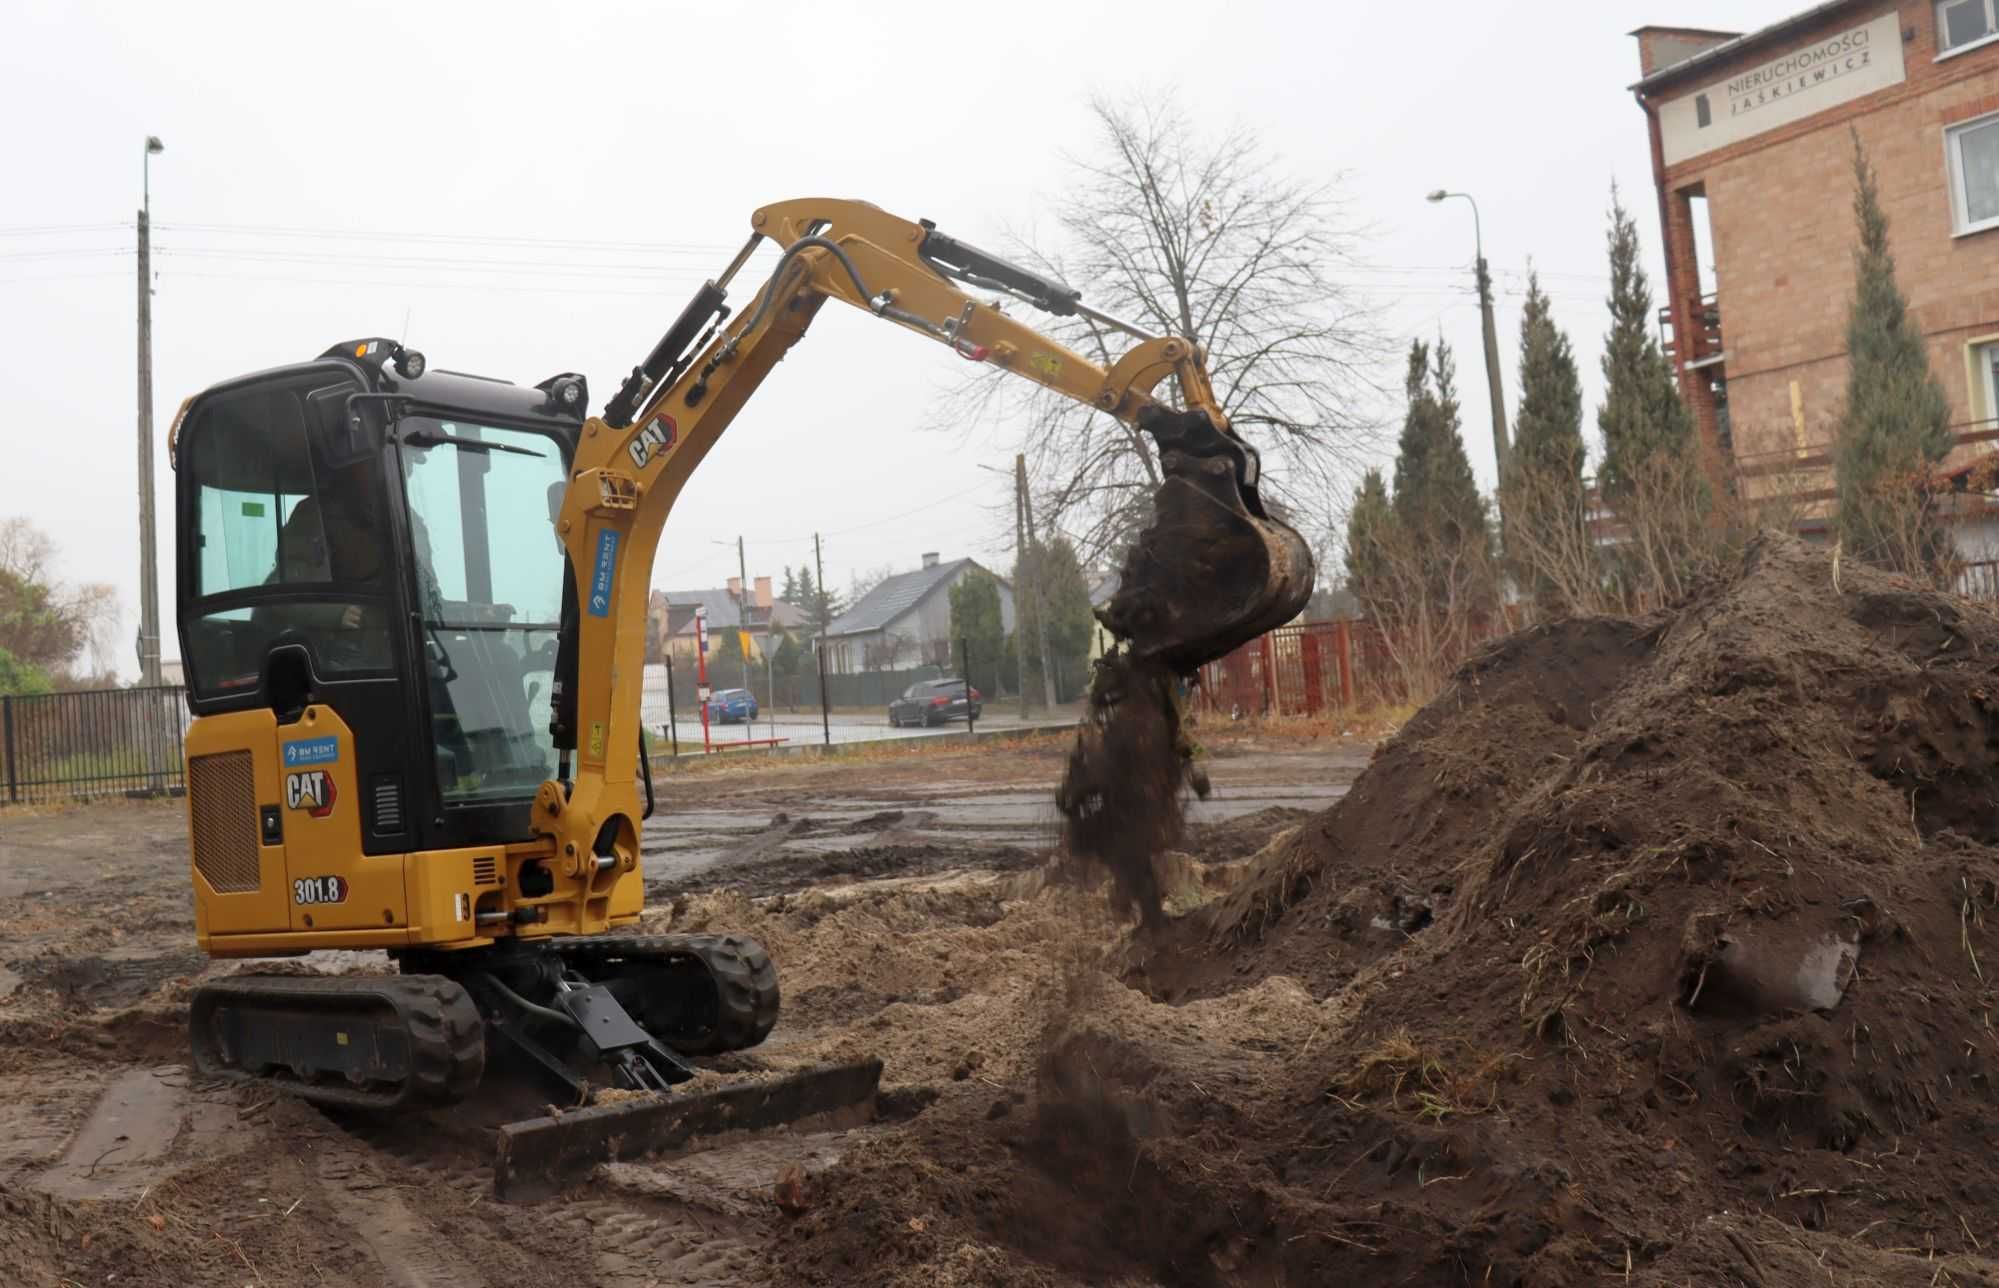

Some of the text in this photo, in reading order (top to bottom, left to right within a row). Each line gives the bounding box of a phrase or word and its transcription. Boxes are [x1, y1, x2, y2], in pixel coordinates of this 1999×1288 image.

[1728, 29, 1870, 96] NIERUCHOMOŚCI
[629, 417, 667, 468] CAT
[287, 771, 324, 809] CAT
[295, 877, 339, 904] 301.8
